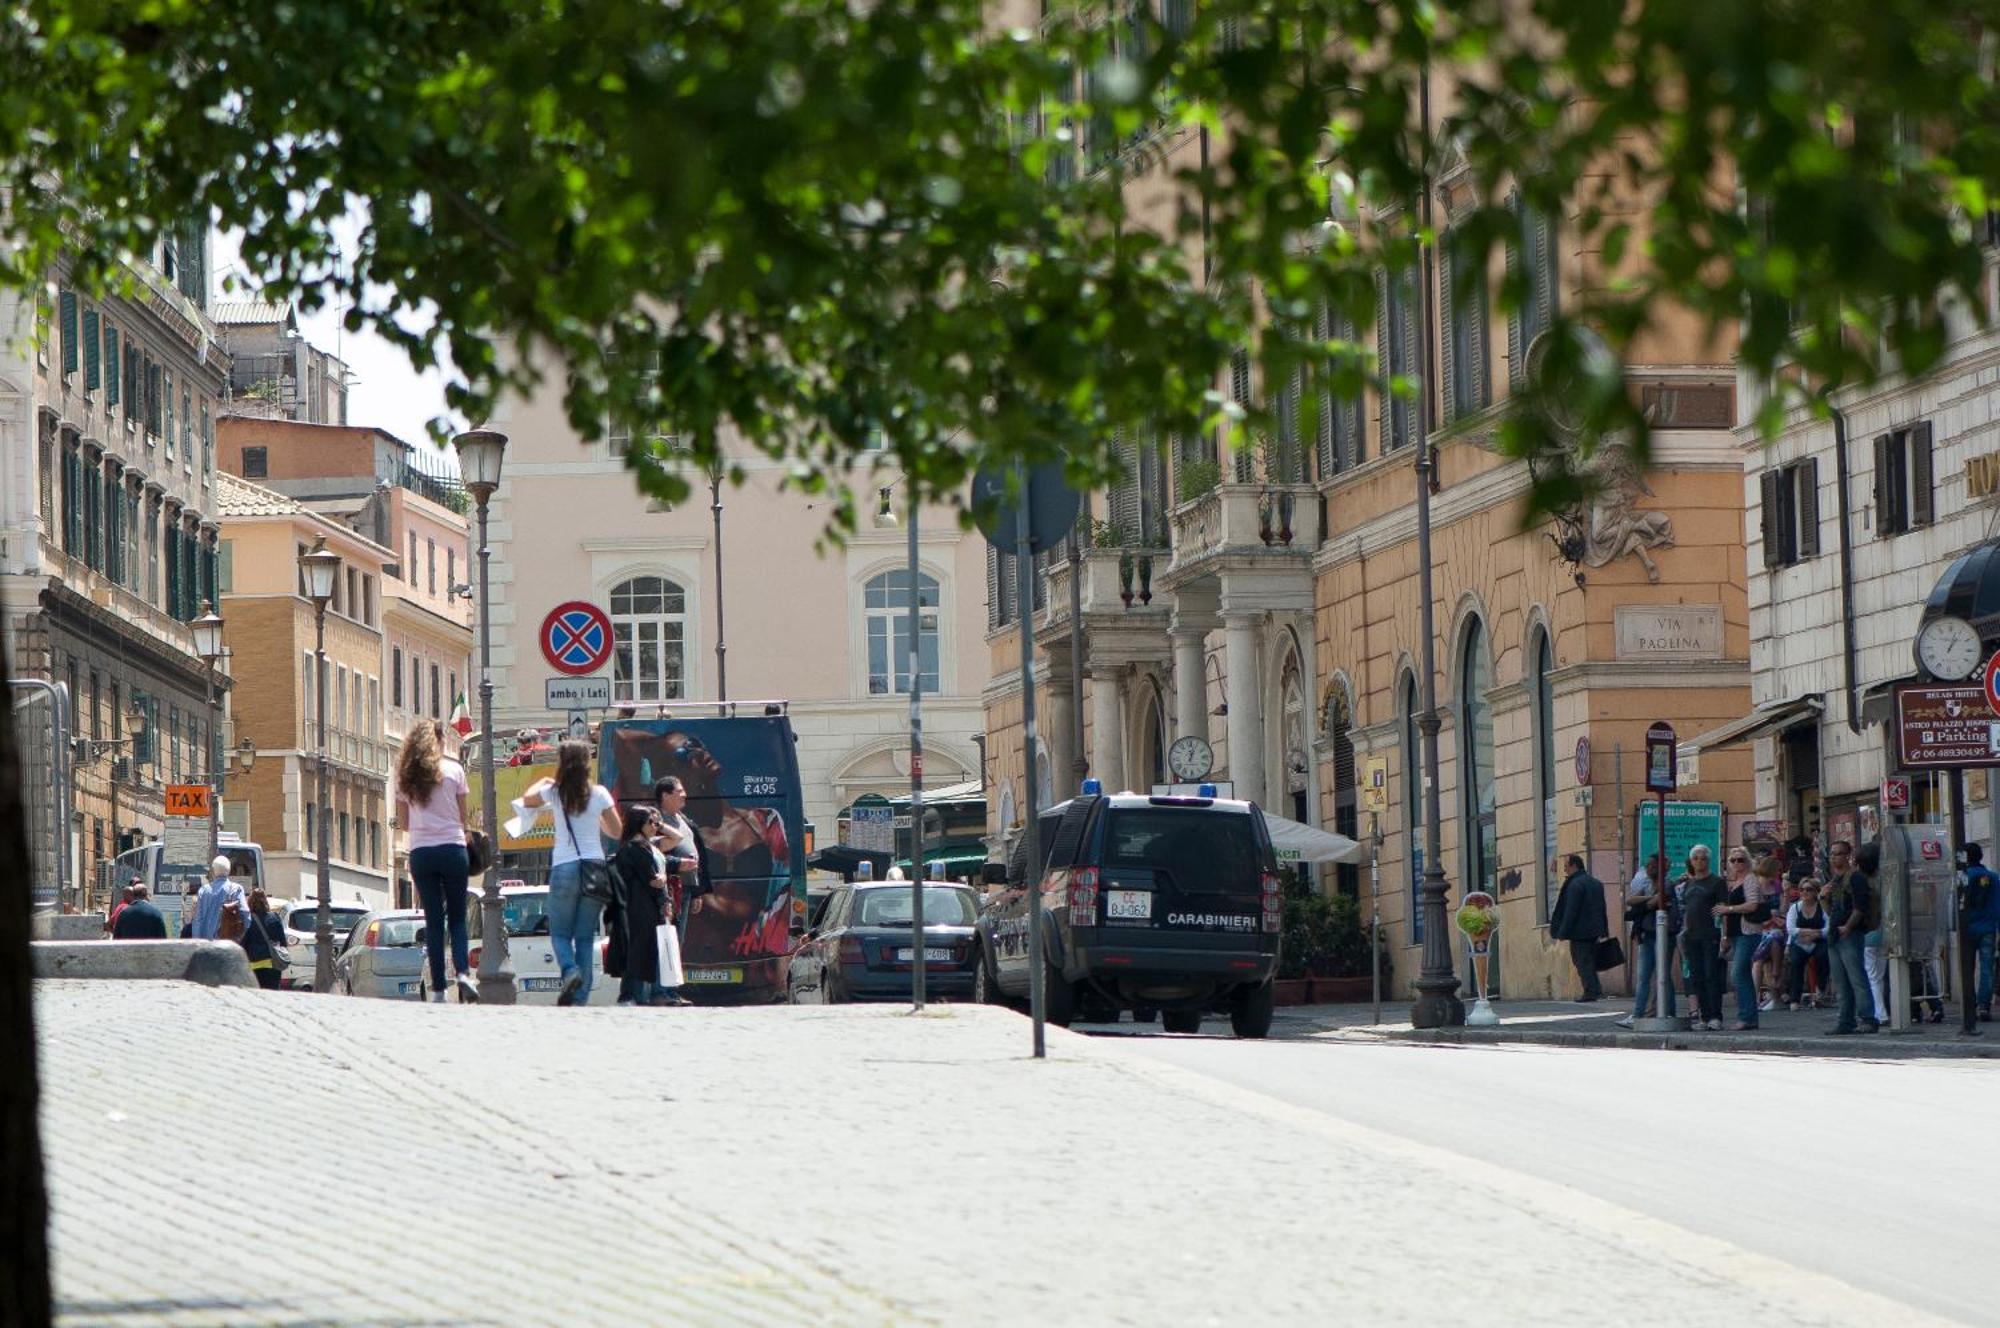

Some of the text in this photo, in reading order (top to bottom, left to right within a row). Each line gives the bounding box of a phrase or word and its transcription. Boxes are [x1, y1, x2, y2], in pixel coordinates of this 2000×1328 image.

[1657, 617, 1681, 630] VIA
[1639, 637, 1701, 649] PAOLINA
[550, 688, 577, 698] ambo
[587, 687, 607, 697] lati
[1937, 731, 1988, 742] Parking
[1923, 749, 1936, 758] 06
[1167, 912, 1256, 928] CARABINIERI
